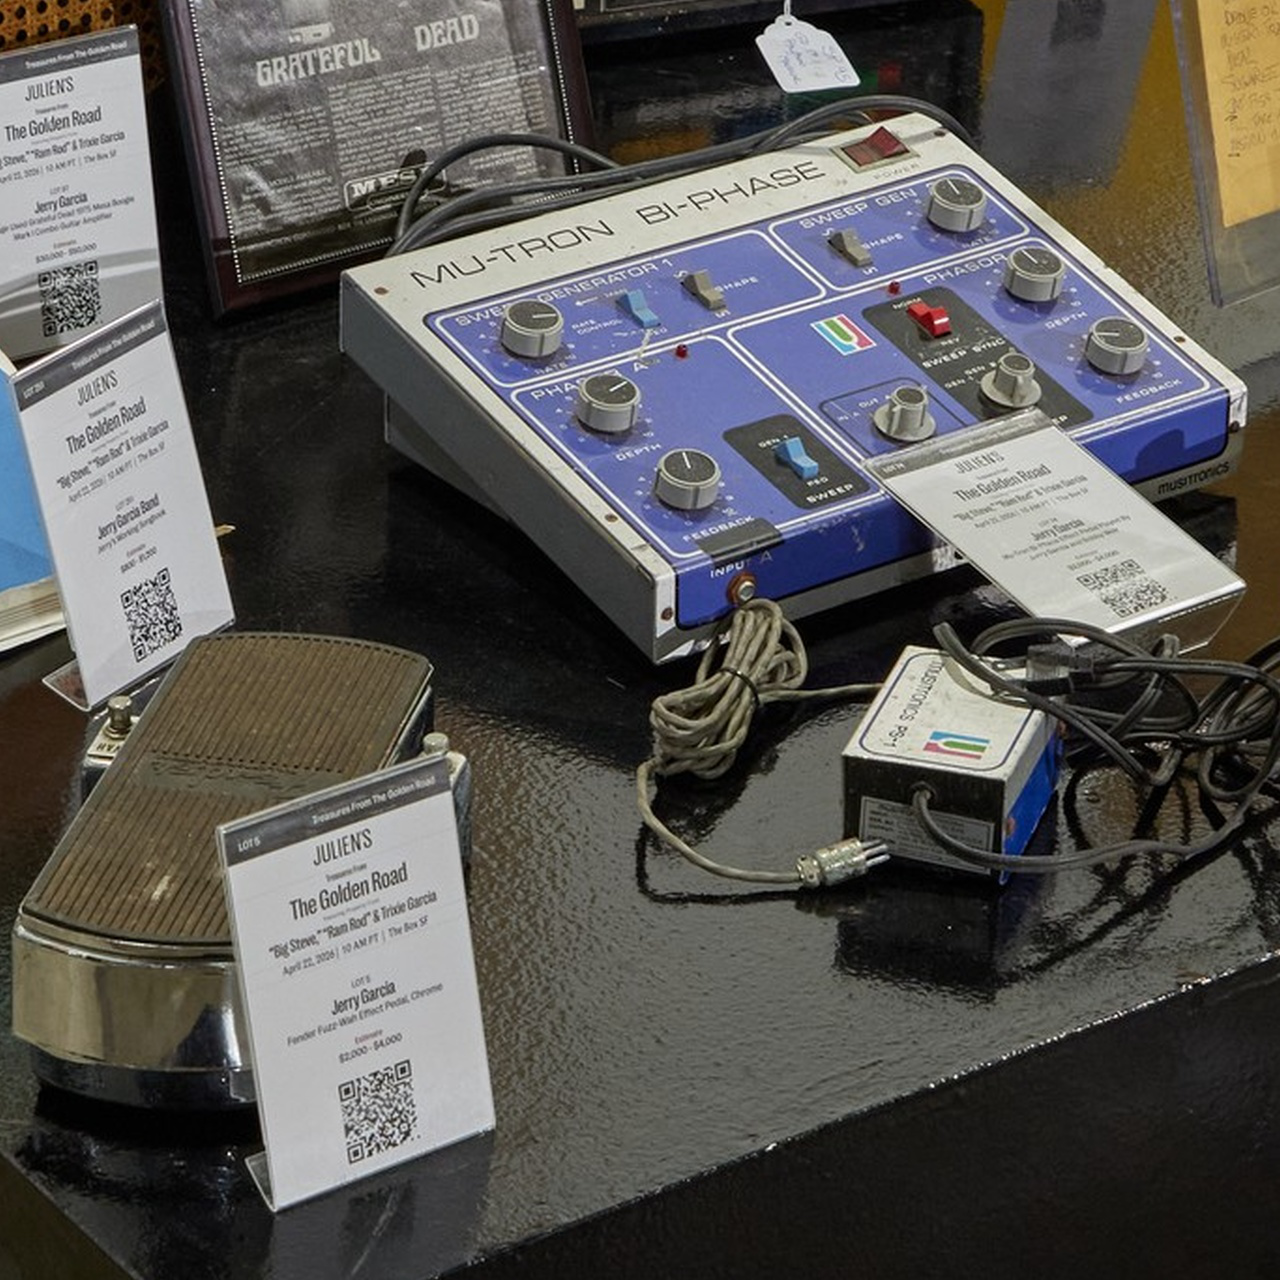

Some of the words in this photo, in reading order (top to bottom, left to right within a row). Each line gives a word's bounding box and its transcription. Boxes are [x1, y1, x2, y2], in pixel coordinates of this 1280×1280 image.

[257, 38, 381, 87] GRATEFUL
[414, 14, 480, 51] DEAD
[25, 75, 74, 101] JULIEN'S
[5, 120, 27, 141] The
[28, 111, 70, 136] Golden
[72, 104, 102, 126] Road
[873, 163, 920, 180] POWER
[33, 196, 58, 214] Jerry
[58, 189, 87, 208] Garcia
[799, 200, 869, 230] SWEEP
[873, 187, 918, 208] GEN
[409, 219, 614, 289] MU-TRON
[636, 161, 825, 225] BI-PHASE
[537, 259, 659, 304] GENERATOR
[923, 252, 1009, 286] PHASOR
[1045, 311, 1089, 331] DEPTH
[922, 349, 968, 370] SWEEP
[971, 337, 1007, 355] SYNC
[75, 367, 118, 405] JULIEN'S
[1116, 378, 1184, 405] FEEDBACK
[66, 427, 87, 454] The
[84, 408, 121, 444] Golden
[119, 394, 146, 424] Road
[614, 442, 663, 462] DEPTH
[806, 482, 854, 505] SWEEP
[954, 486, 980, 499] The
[976, 473, 1020, 492] Golden
[1017, 463, 1051, 479] Road
[96, 516, 117, 540] Jerry
[115, 503, 141, 529] Garcia
[139, 492, 159, 515] Band
[682, 514, 756, 543] FEEDBACK
[312, 803, 349, 825] Treasures
[349, 796, 370, 812] From
[370, 790, 385, 805] The
[386, 781, 413, 799] Golden
[414, 773, 435, 790] Road
[237, 837, 253, 852] LOT
[311, 826, 373, 866] JULIEN'S
[289, 892, 317, 922] The
[317, 874, 369, 912] Golden
[371, 860, 408, 893] Road
[268, 941, 290, 963] "Big
[322, 920, 348, 942] "Ram
[348, 912, 371, 932] Rod"
[372, 910, 379, 923] &
[381, 899, 406, 920] Trixie
[406, 888, 437, 911] Garcia
[281, 960, 301, 978] April
[302, 954, 318, 971] 22,
[342, 942, 350, 956] 10
[350, 937, 366, 953] AM
[366, 932, 379, 947] PT
[387, 923, 402, 939] The
[402, 918, 417, 934] Box
[417, 914, 428, 928] SF
[330, 991, 361, 1017] Jerry
[360, 978, 396, 1006] Garcia
[350, 976, 364, 989] LOT
